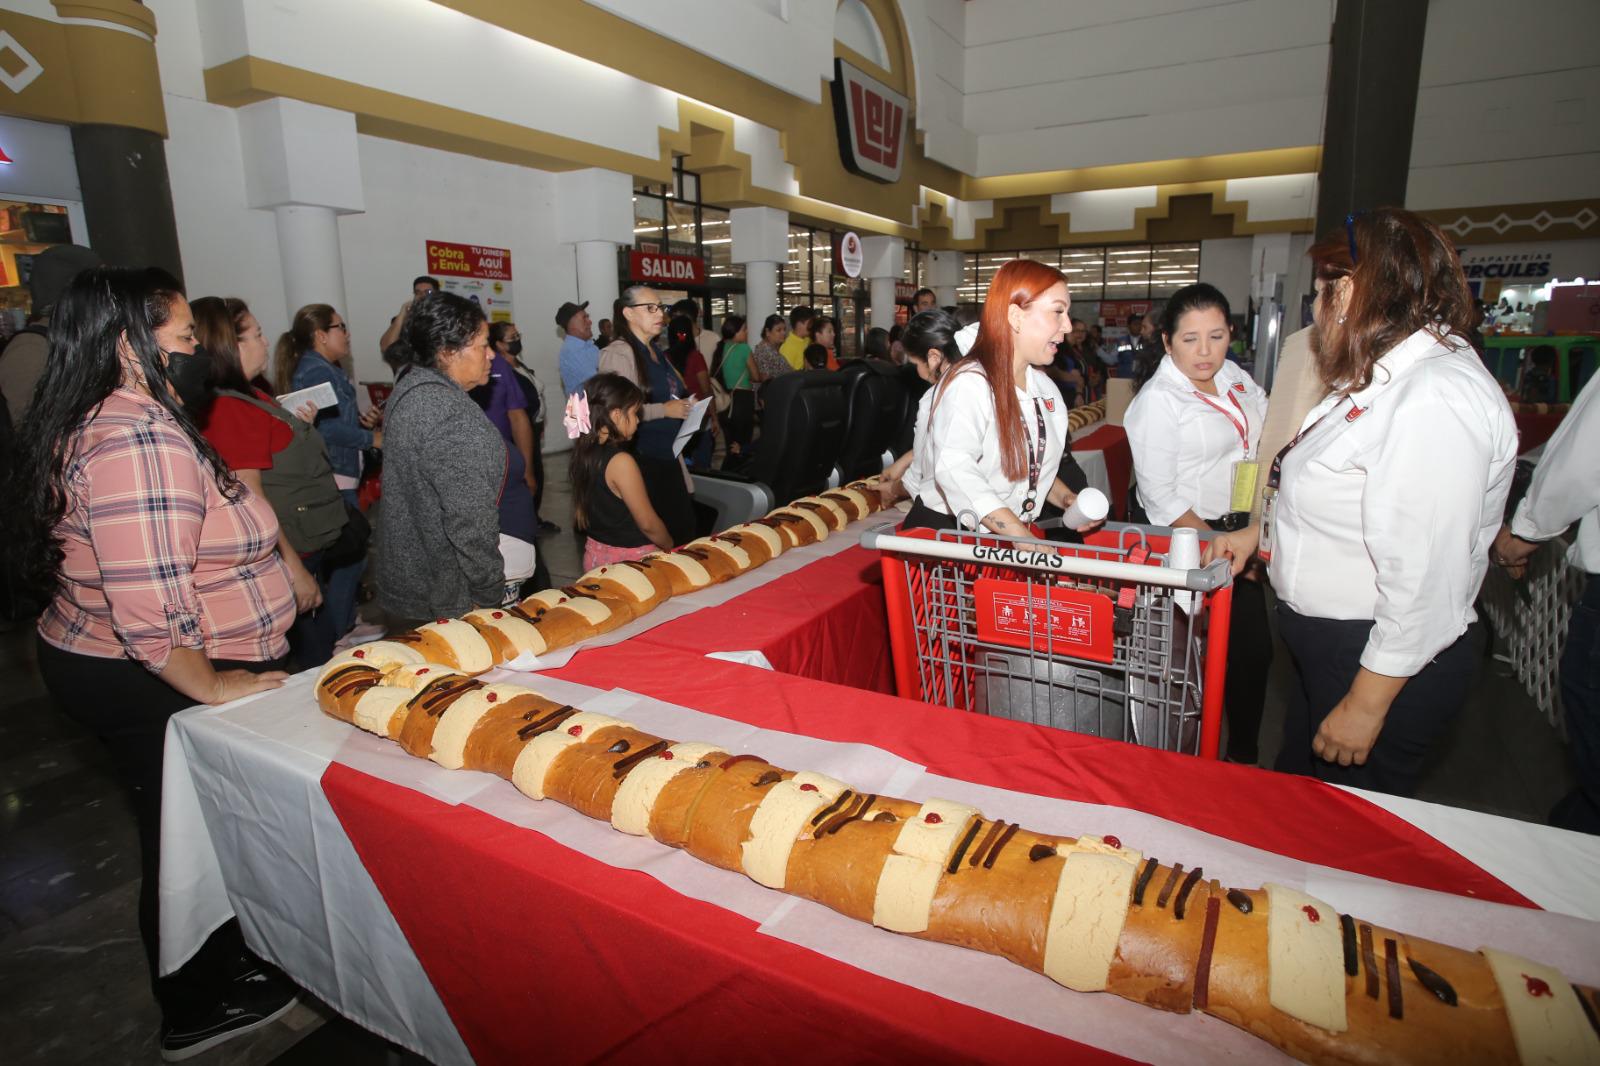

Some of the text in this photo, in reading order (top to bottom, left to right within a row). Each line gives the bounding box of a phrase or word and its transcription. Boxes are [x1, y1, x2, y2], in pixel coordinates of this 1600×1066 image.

[430, 245, 465, 260] Cobra
[471, 246, 482, 256] TU
[641, 256, 695, 280] SALIDA
[1463, 261, 1550, 278] ERCULES
[972, 545, 1064, 569] GRACIAS
